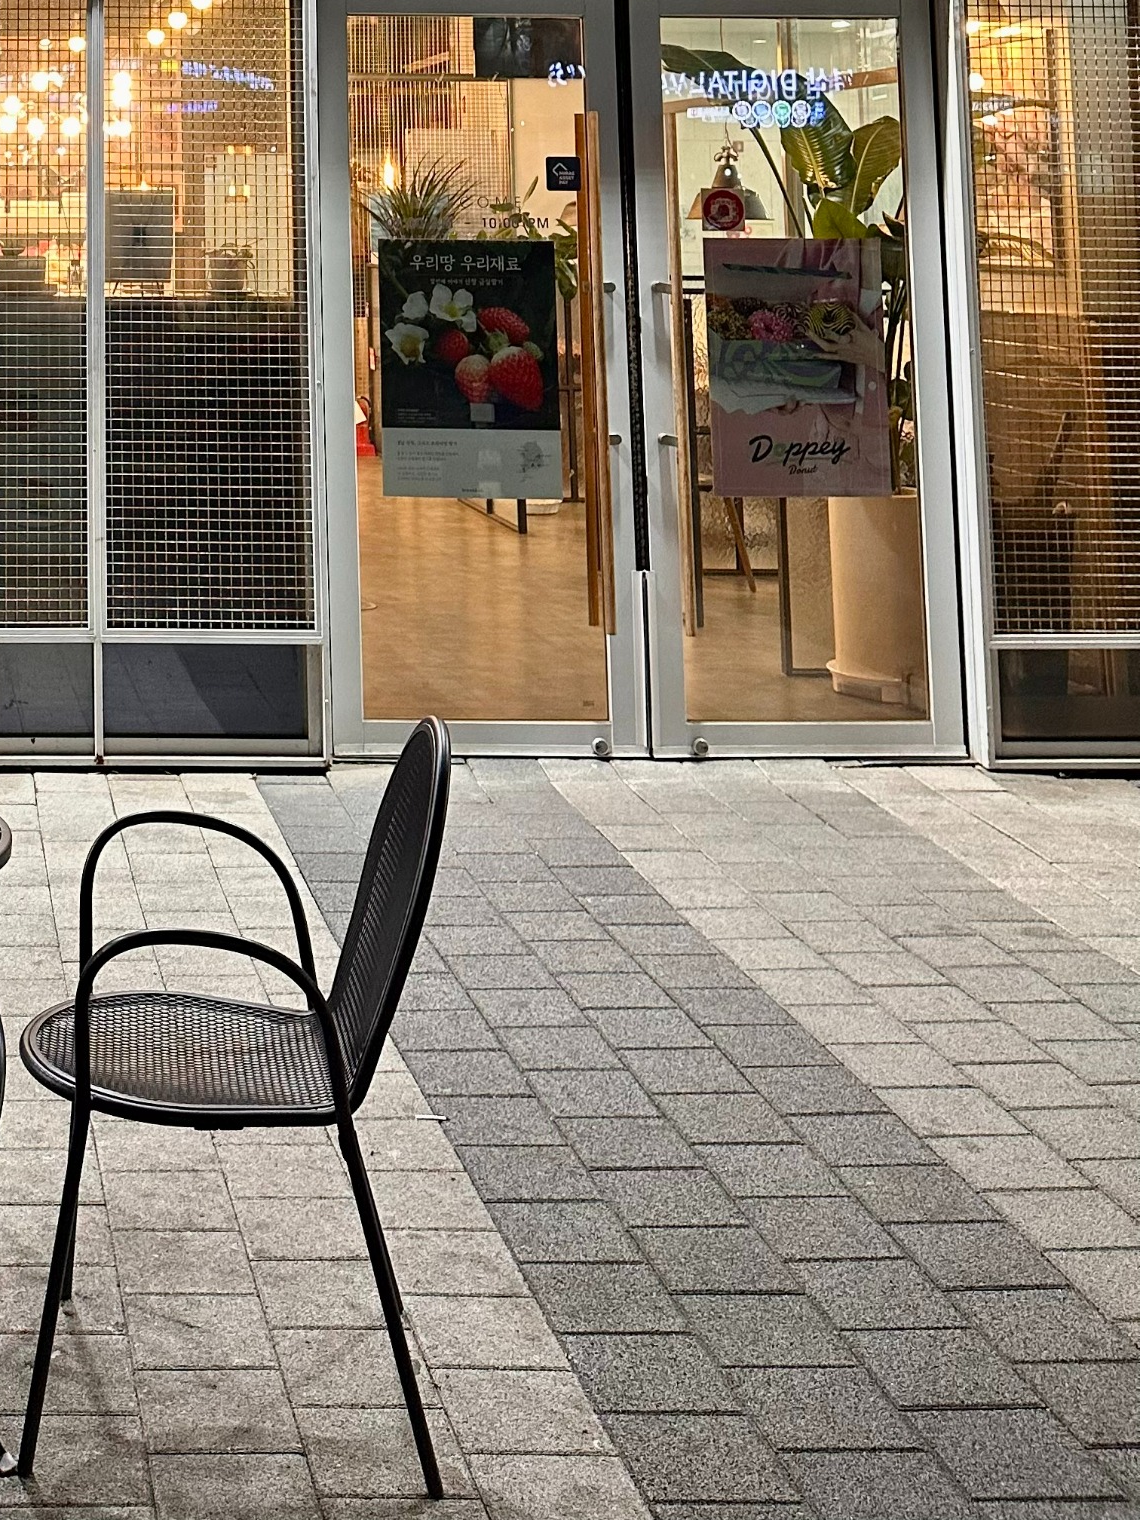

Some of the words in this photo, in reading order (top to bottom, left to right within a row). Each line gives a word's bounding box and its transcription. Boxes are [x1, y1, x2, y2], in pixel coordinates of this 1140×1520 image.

[410, 254, 455, 272] 우리땅
[460, 254, 522, 272] 우리재료
[749, 435, 851, 466] Doppey
[789, 464, 818, 475] Donut
